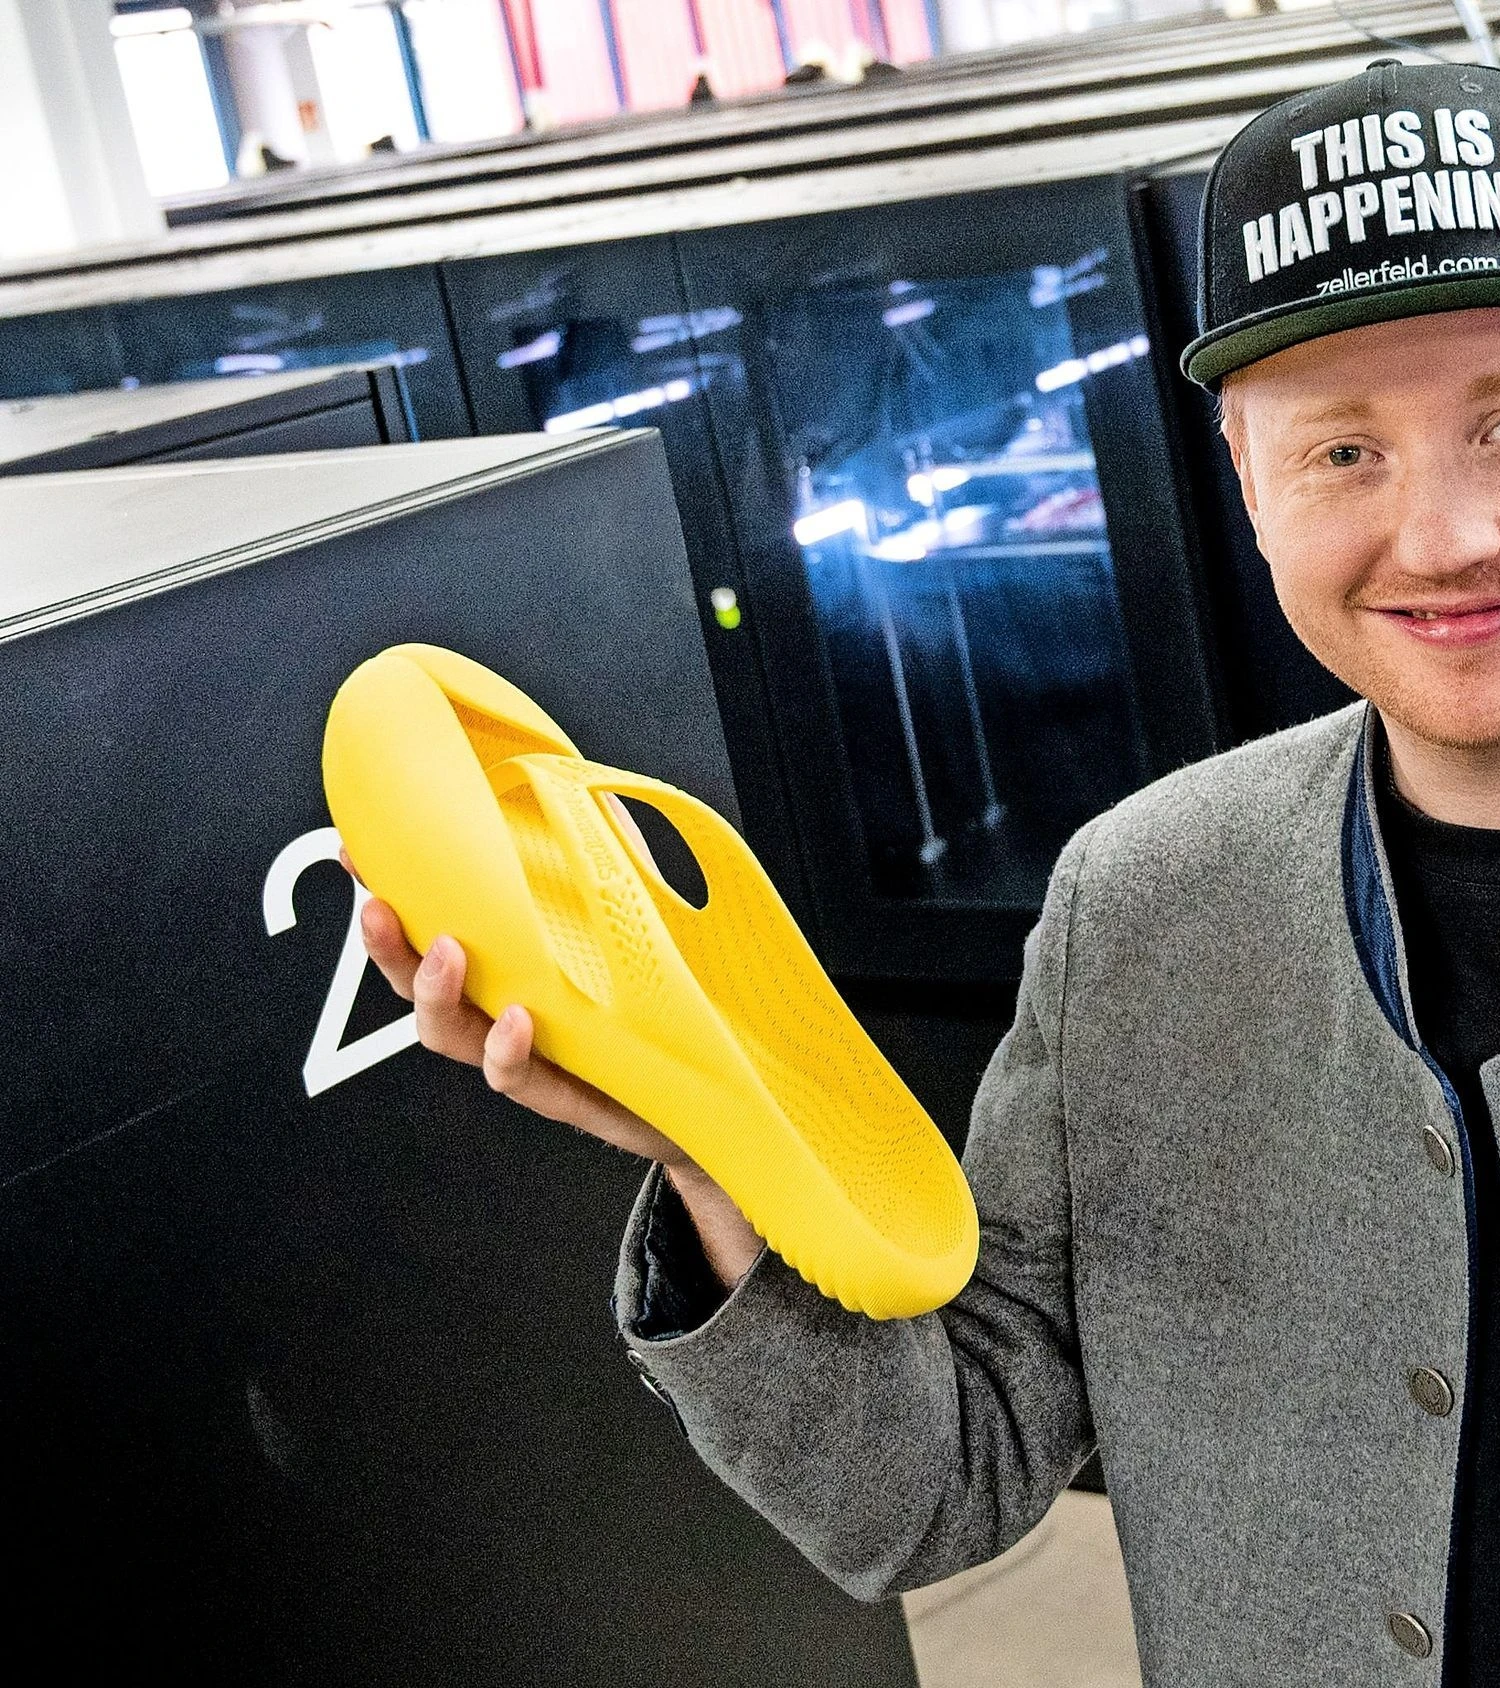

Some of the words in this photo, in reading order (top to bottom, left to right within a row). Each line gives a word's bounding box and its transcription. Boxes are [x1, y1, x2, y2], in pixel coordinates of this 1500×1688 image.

[1291, 110, 1426, 191] THIS
[1434, 108, 1495, 167] IS
[1316, 254, 1498, 297] zellerfeld.com
